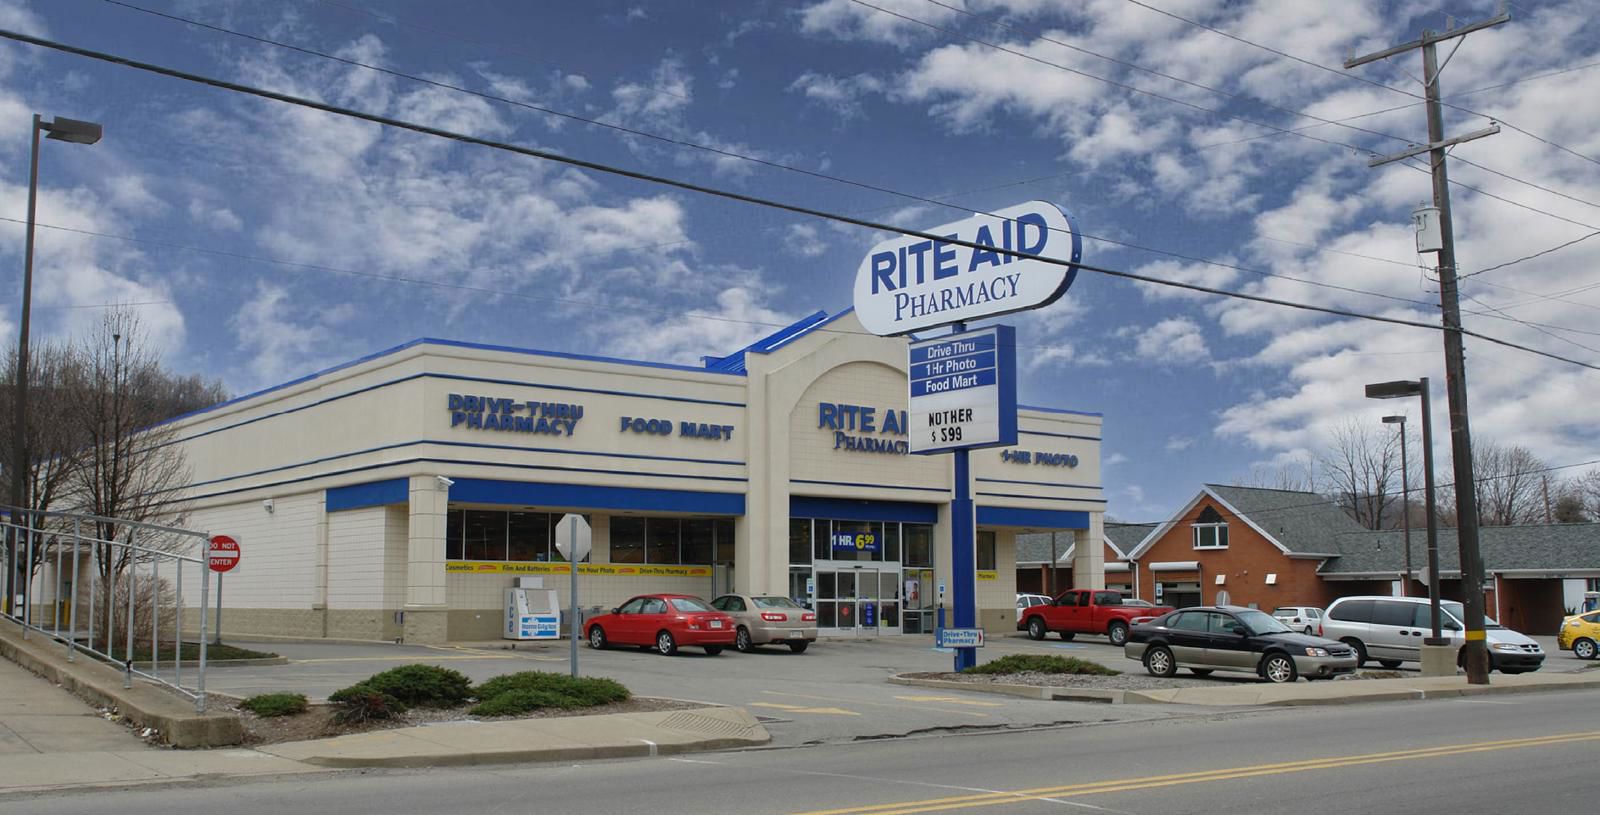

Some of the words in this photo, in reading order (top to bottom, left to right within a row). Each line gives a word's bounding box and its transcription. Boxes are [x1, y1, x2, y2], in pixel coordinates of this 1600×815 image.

[871, 233, 959, 295] RITE
[968, 212, 1048, 273] AID
[927, 346, 951, 359] Drive
[952, 342, 976, 354] Thru
[926, 364, 930, 375] 1
[932, 363, 944, 374] Hr
[946, 359, 977, 372] Photo
[926, 378, 949, 392] Food
[952, 375, 977, 388] Mart
[448, 393, 583, 420] DRIVE-THRU
[450, 411, 579, 437] PHARMACY
[817, 402, 876, 432] RITE
[880, 408, 908, 435] AI
[929, 408, 973, 426] NOTHER
[619, 416, 673, 436] FOOD
[679, 421, 734, 441] MART
[1034, 451, 1078, 469] PHOTO
[839, 535, 855, 546] HR.
